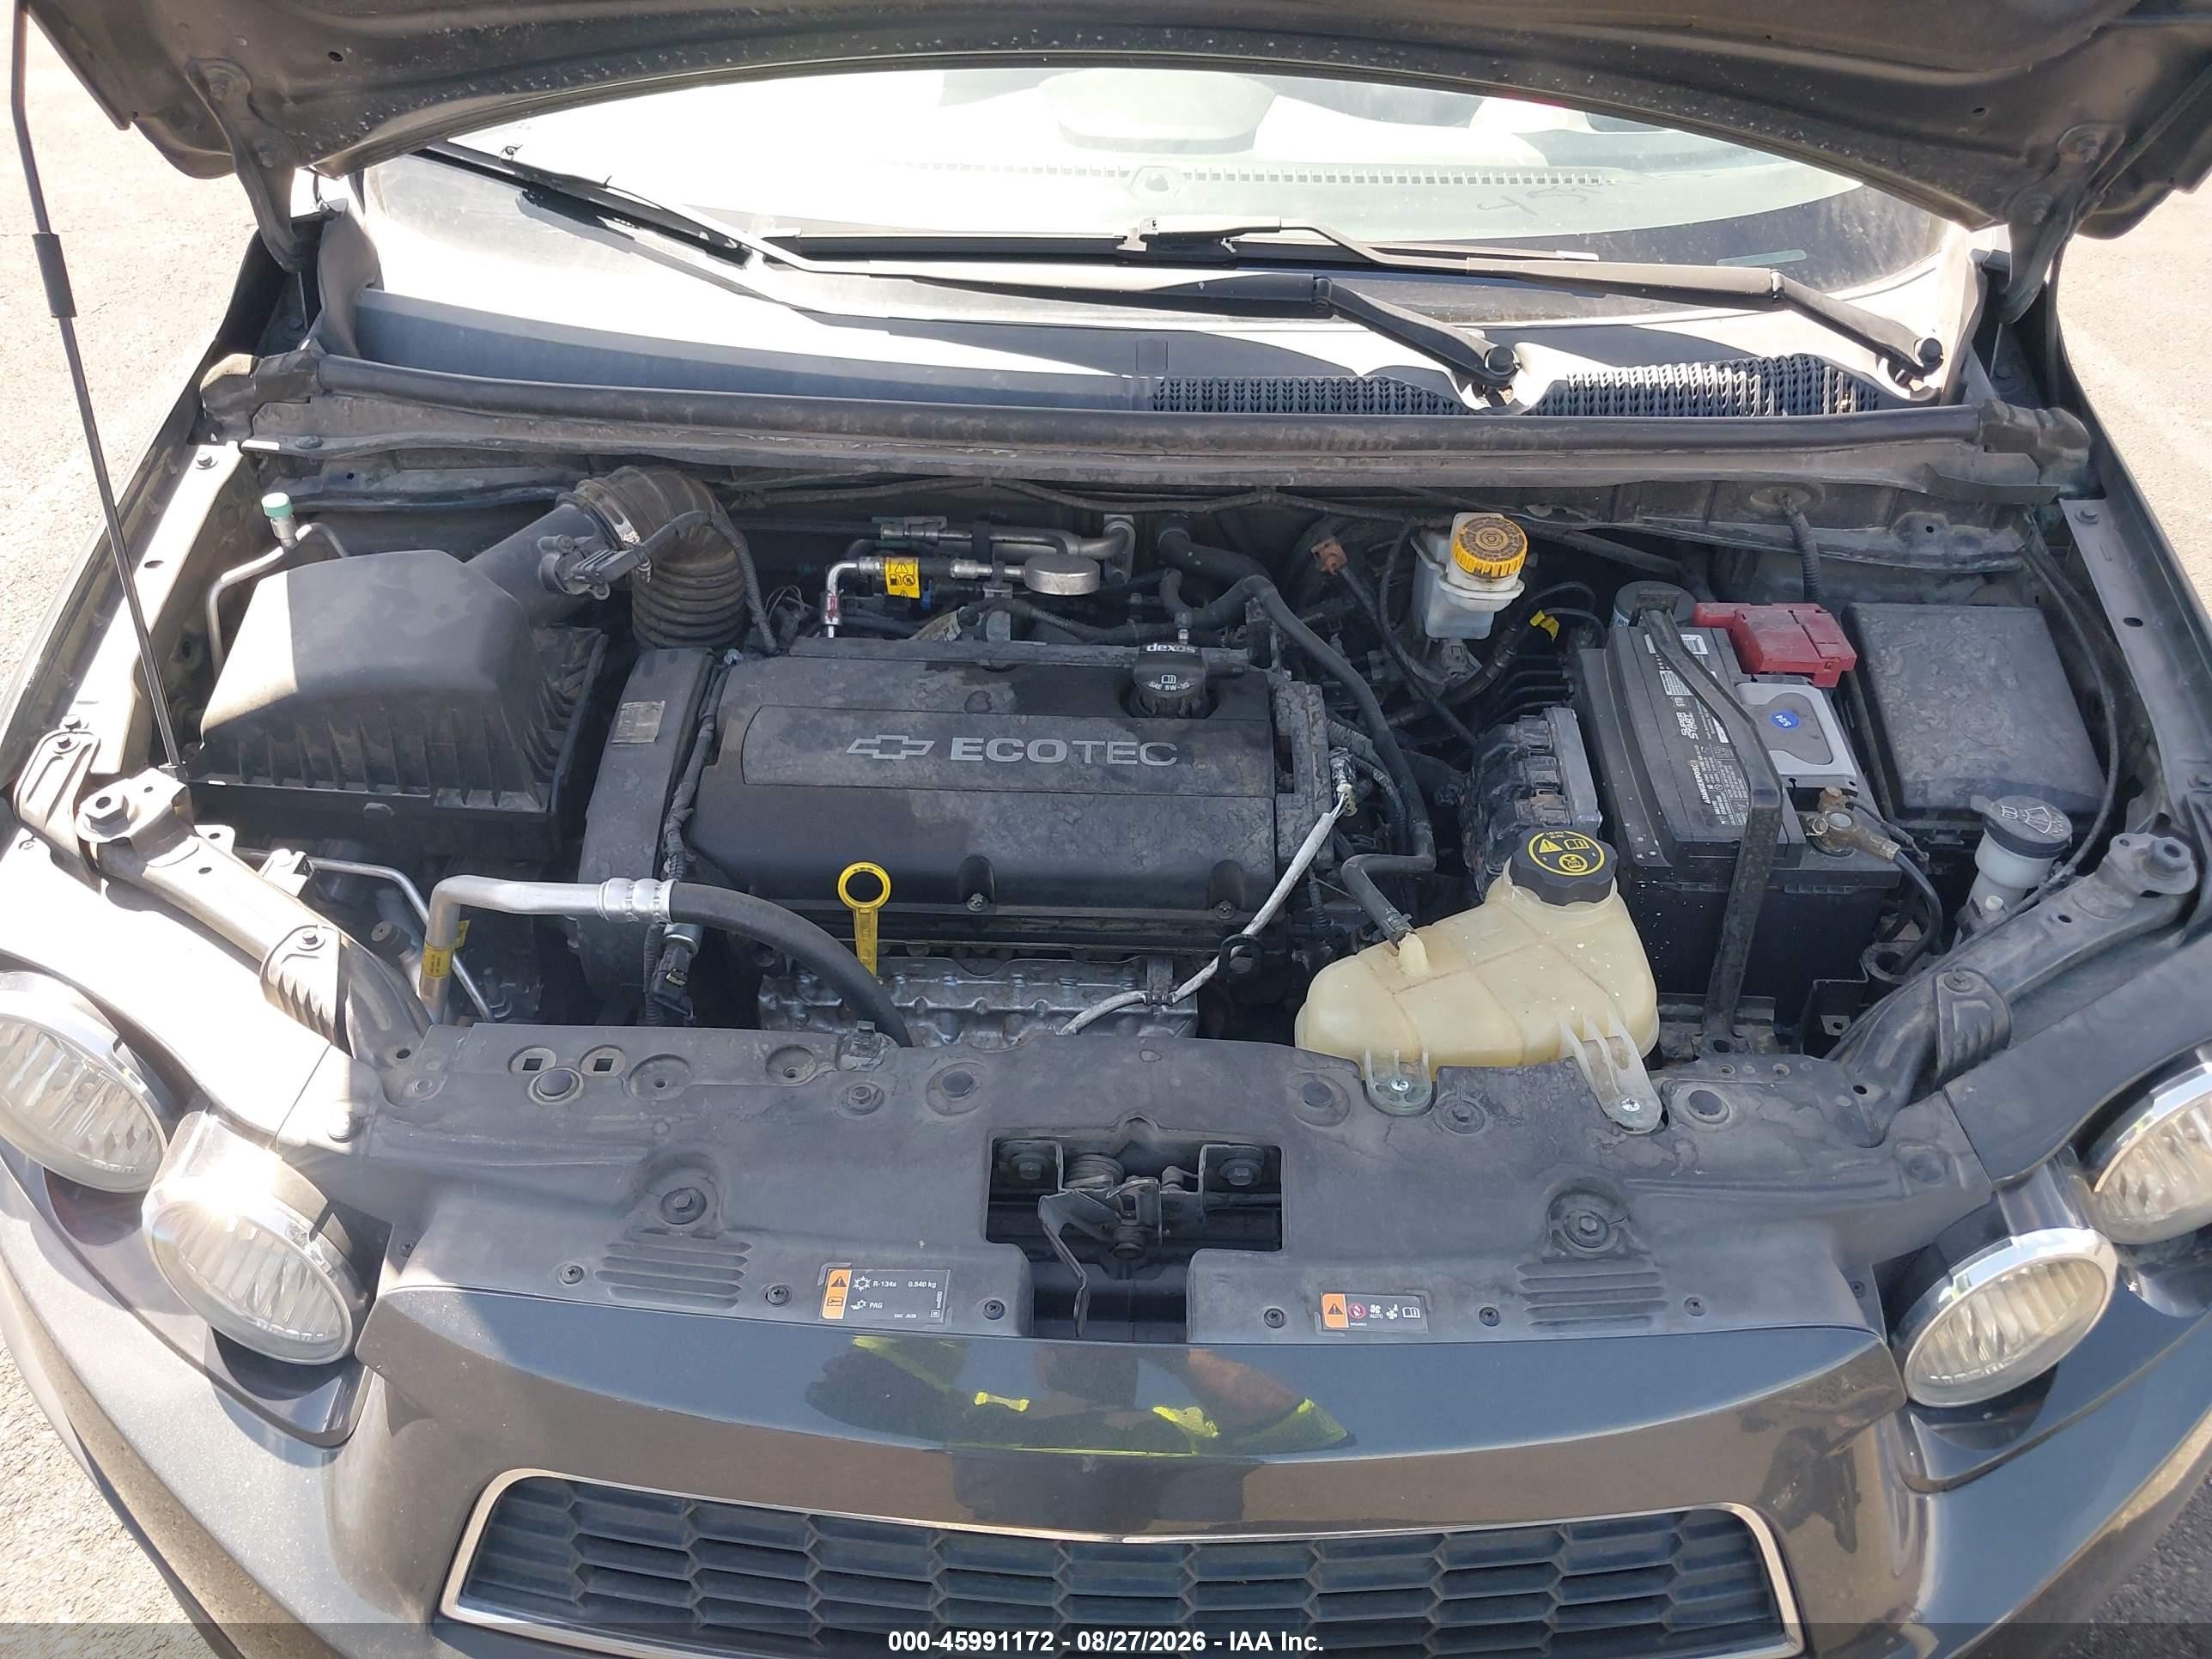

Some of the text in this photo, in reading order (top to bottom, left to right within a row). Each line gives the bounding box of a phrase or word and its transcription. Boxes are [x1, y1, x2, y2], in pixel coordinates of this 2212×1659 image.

[1146, 642, 1196, 653] dexos
[1148, 681, 1190, 690] SAE 5W-30
[1675, 712, 1688, 736] SUPER
[1684, 712, 1699, 740] START
[950, 737, 1178, 767] ECOTEC
